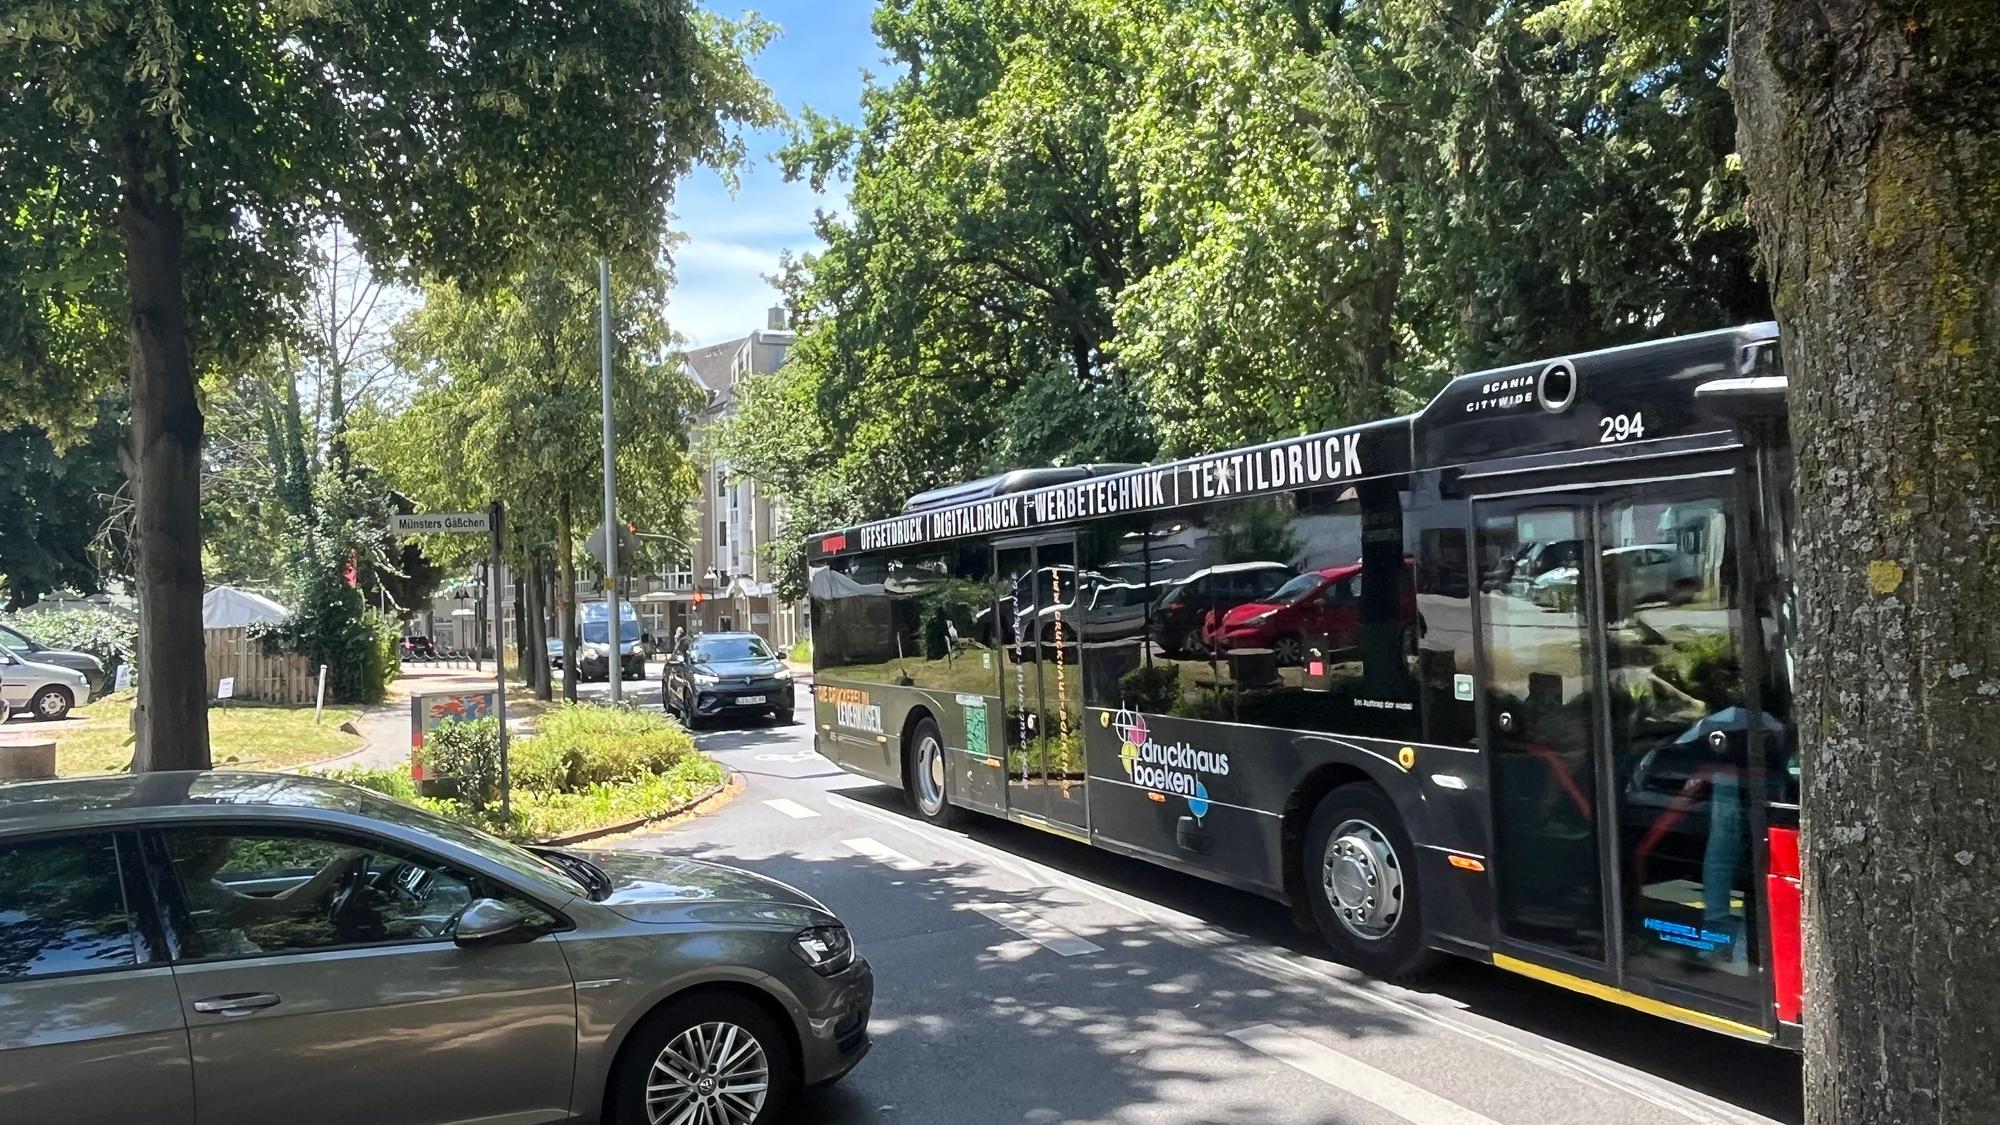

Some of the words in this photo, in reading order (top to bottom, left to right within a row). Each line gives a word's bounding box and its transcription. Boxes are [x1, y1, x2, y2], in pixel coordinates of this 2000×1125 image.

[1466, 392, 1533, 412] CITYWIDE
[1483, 375, 1534, 394] SCANIA
[1600, 412, 1645, 443] 294
[860, 516, 923, 550] OFFSETDRUCK
[933, 497, 1019, 539] DIGITALDRUCK
[1034, 470, 1164, 523] WERBETECHNIK
[1188, 433, 1363, 499] TEXTILDRUCK
[399, 519, 442, 529] Münsters
[445, 518, 485, 528] Gäßchen
[1012, 572, 1029, 790] WWWDRUCKHAUS-BOEKEN.DE
[1051, 567, 1070, 800] WWWDRUCKHAUS-BOEKEN.DE
[1141, 737, 1230, 776] druckhaus
[1133, 759, 1195, 795] boeken
